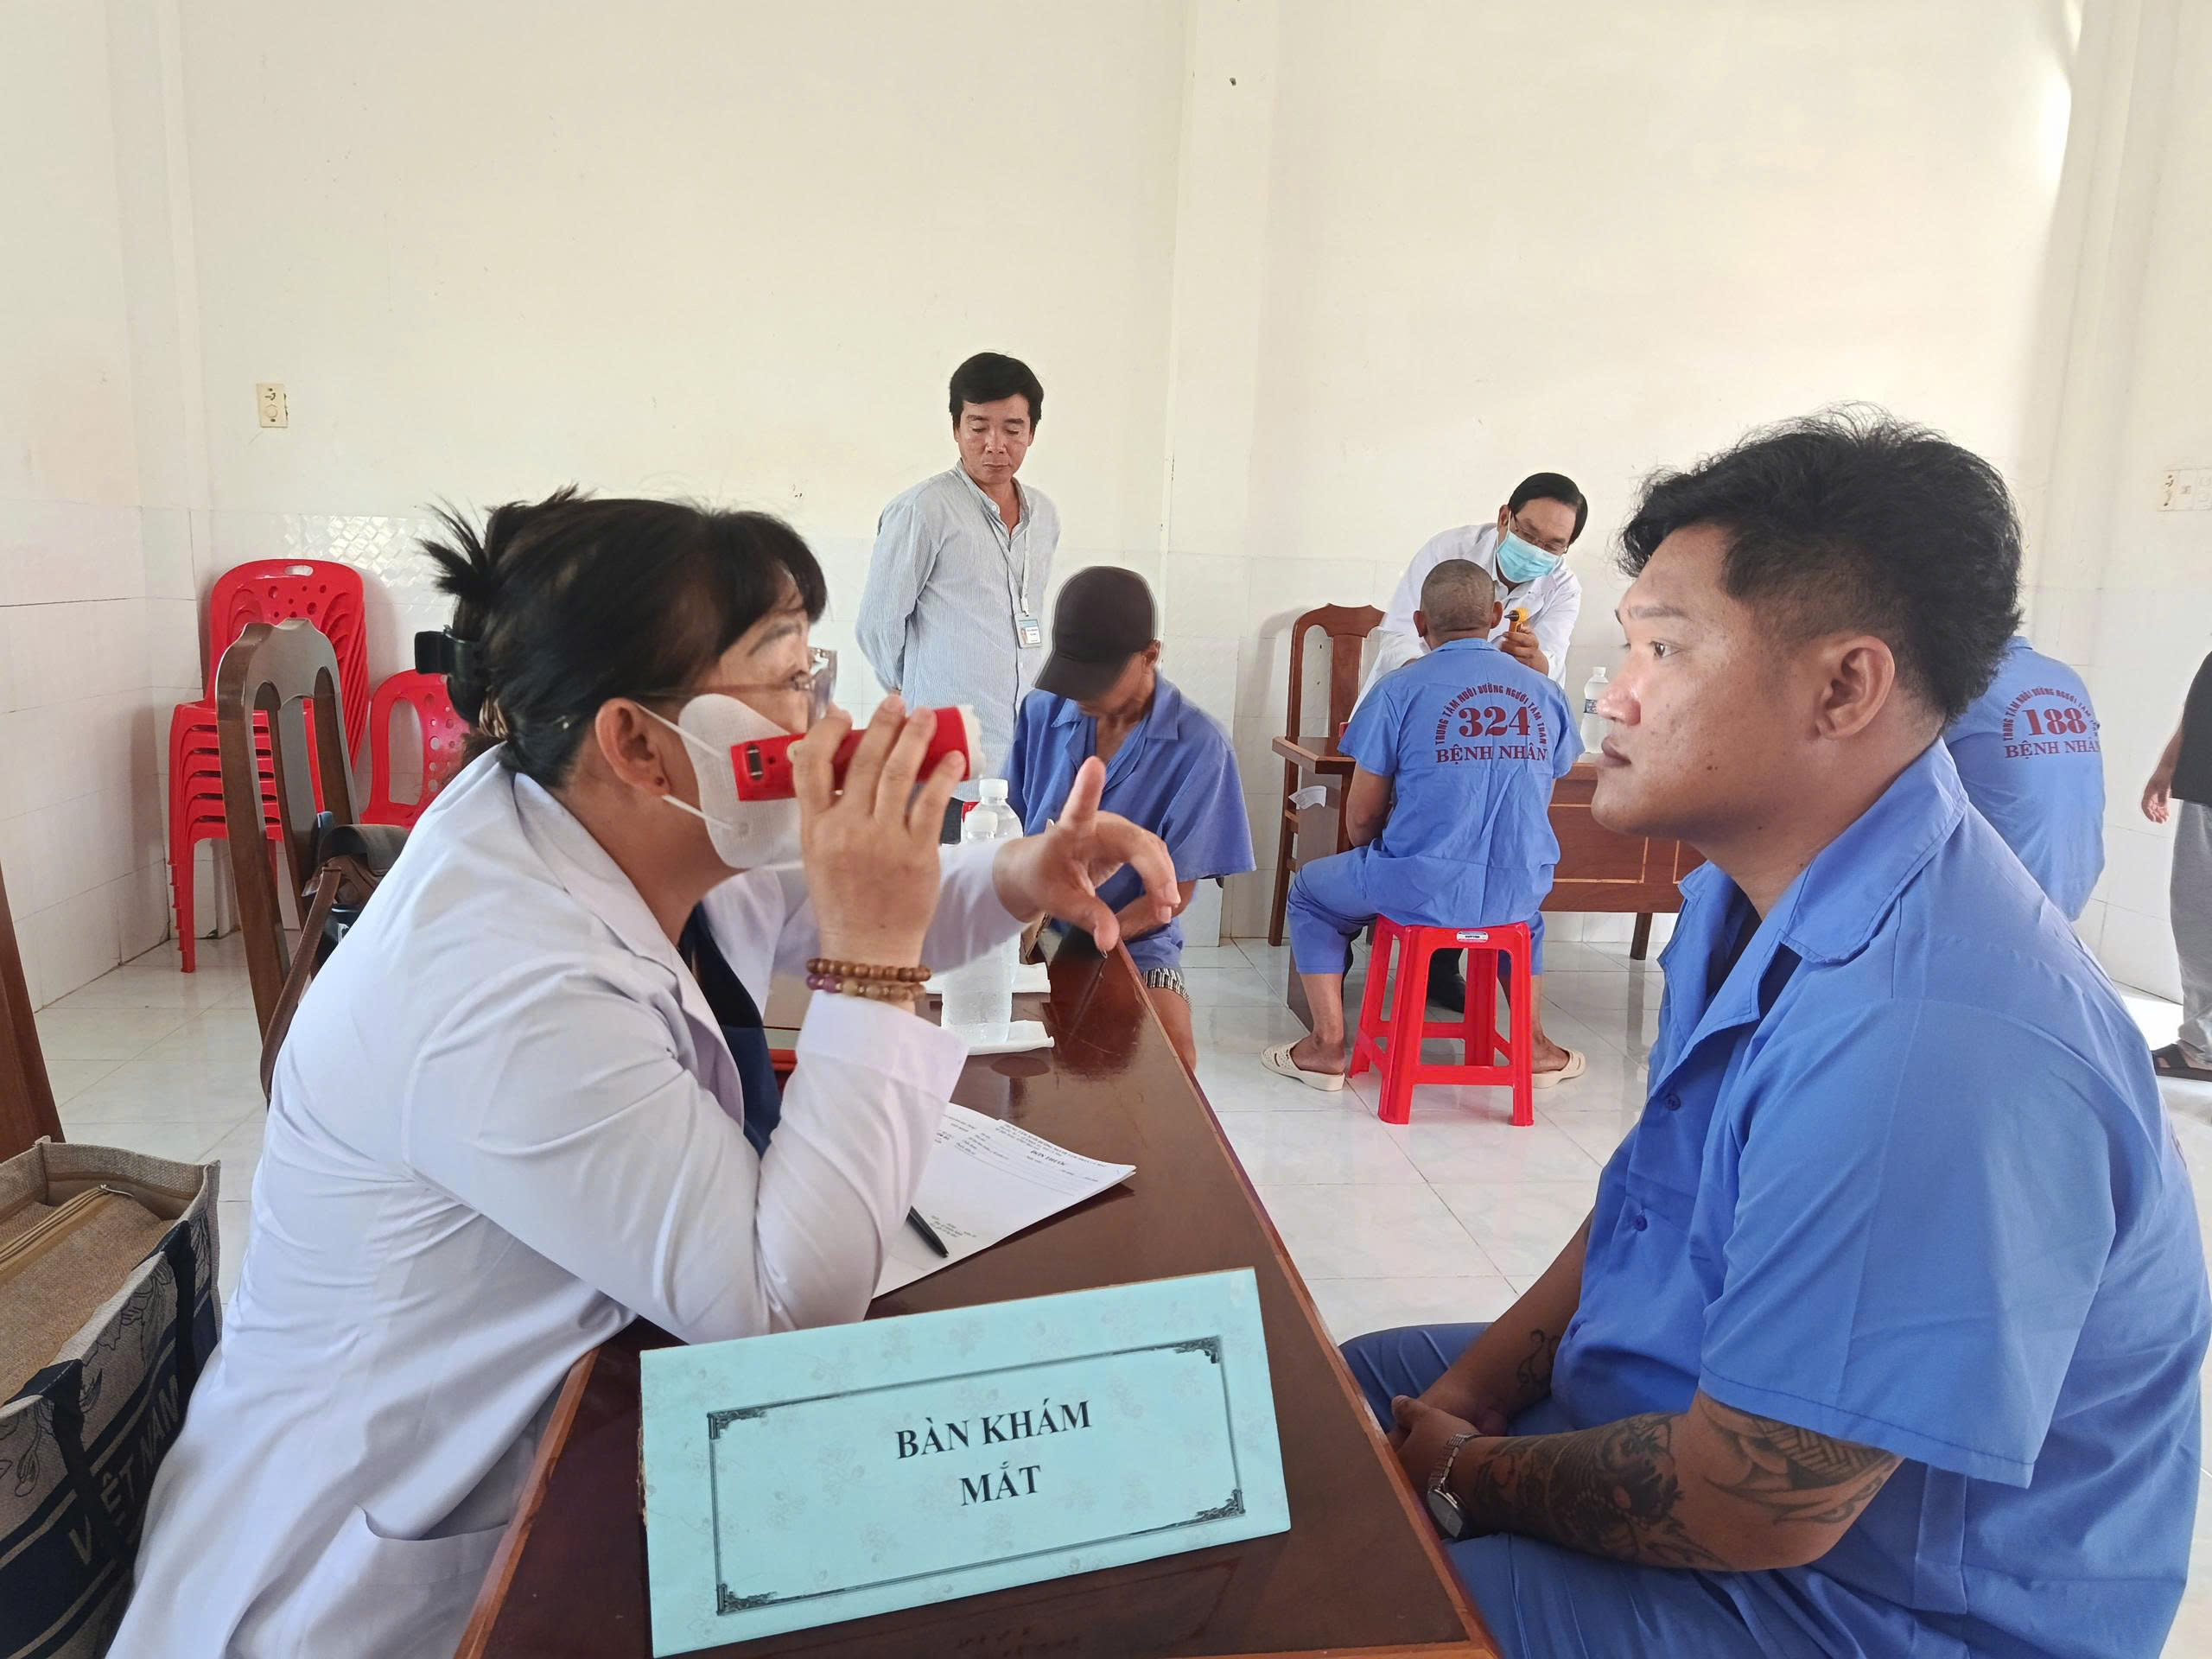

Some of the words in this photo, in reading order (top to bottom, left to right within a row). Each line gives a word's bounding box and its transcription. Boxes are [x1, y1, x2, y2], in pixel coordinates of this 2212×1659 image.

[1435, 718, 1449, 745] TRUNG
[1442, 699, 1460, 717] TÂM
[1459, 706, 1530, 737] 324
[2022, 708, 2087, 735] 188
[1435, 743, 1493, 765] BỆNH
[1499, 743, 1548, 761] NHÂN
[2005, 740, 2060, 760] BỆNH
[895, 1416, 970, 1459] BÀN
[980, 1397, 1092, 1446] KHÁM
[959, 1461, 1042, 1506] MẮT
[69, 1452, 136, 1565] VỆT
